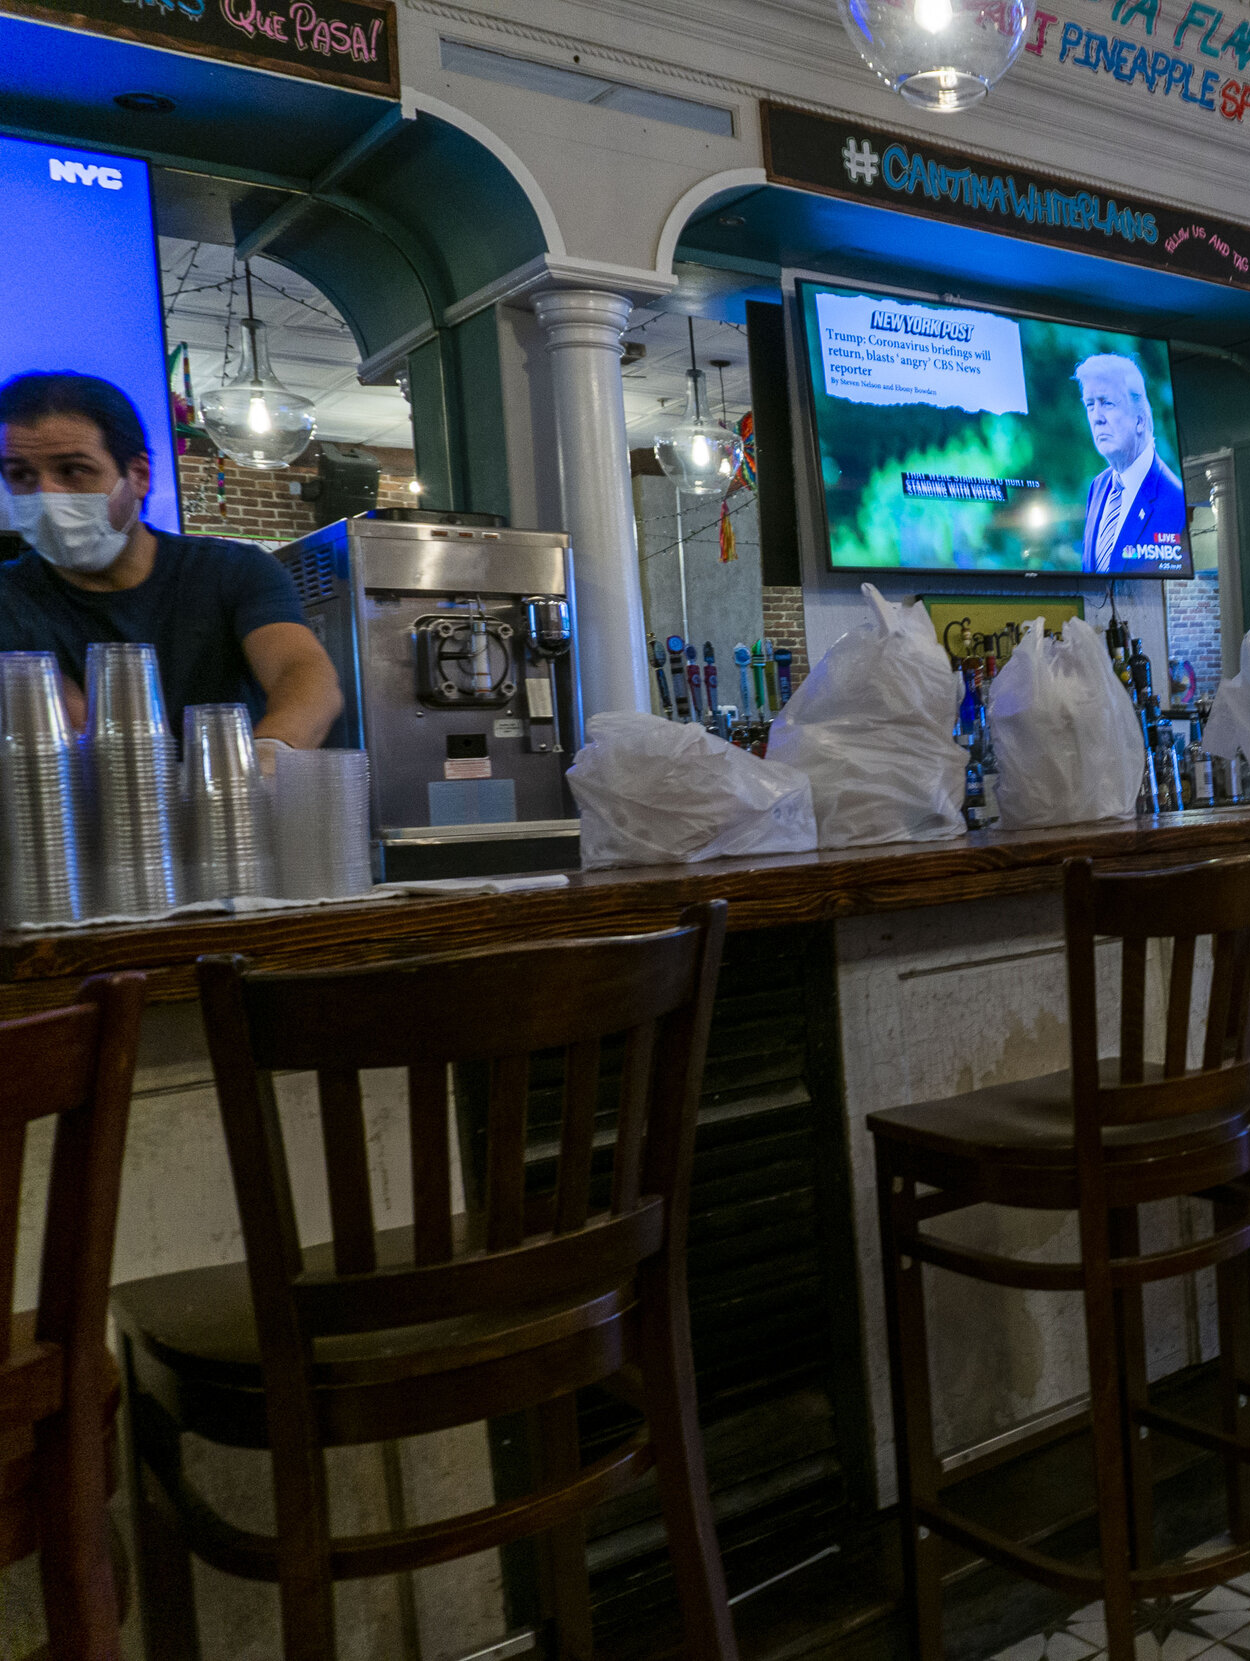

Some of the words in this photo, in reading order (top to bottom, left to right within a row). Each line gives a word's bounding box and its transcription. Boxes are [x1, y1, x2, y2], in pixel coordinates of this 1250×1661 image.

[289, 1, 381, 62] PASA!
[1058, 21, 1220, 111] PINEAPPLE
[48, 158, 123, 190] NYC
[1208, 234, 1231, 257] AND
[1233, 250, 1249, 273] TAG
[870, 310, 904, 333] NEW
[902, 314, 941, 338] YORK
[938, 320, 975, 343] POST
[826, 328, 866, 346] Trump:
[868, 334, 930, 353] Coronavirus
[931, 343, 972, 361] briefings
[974, 350, 991, 361] will
[828, 347, 864, 361] return,
[866, 349, 894, 363] blasts
[933, 358, 954, 371] CBS
[956, 362, 981, 374] News
[830, 363, 872, 376] reporter
[904, 479, 948, 498] STANDING
[947, 482, 971, 500] WITH
[1136, 544, 1183, 561] MSNBC
[1157, 533, 1176, 543] LIVE
